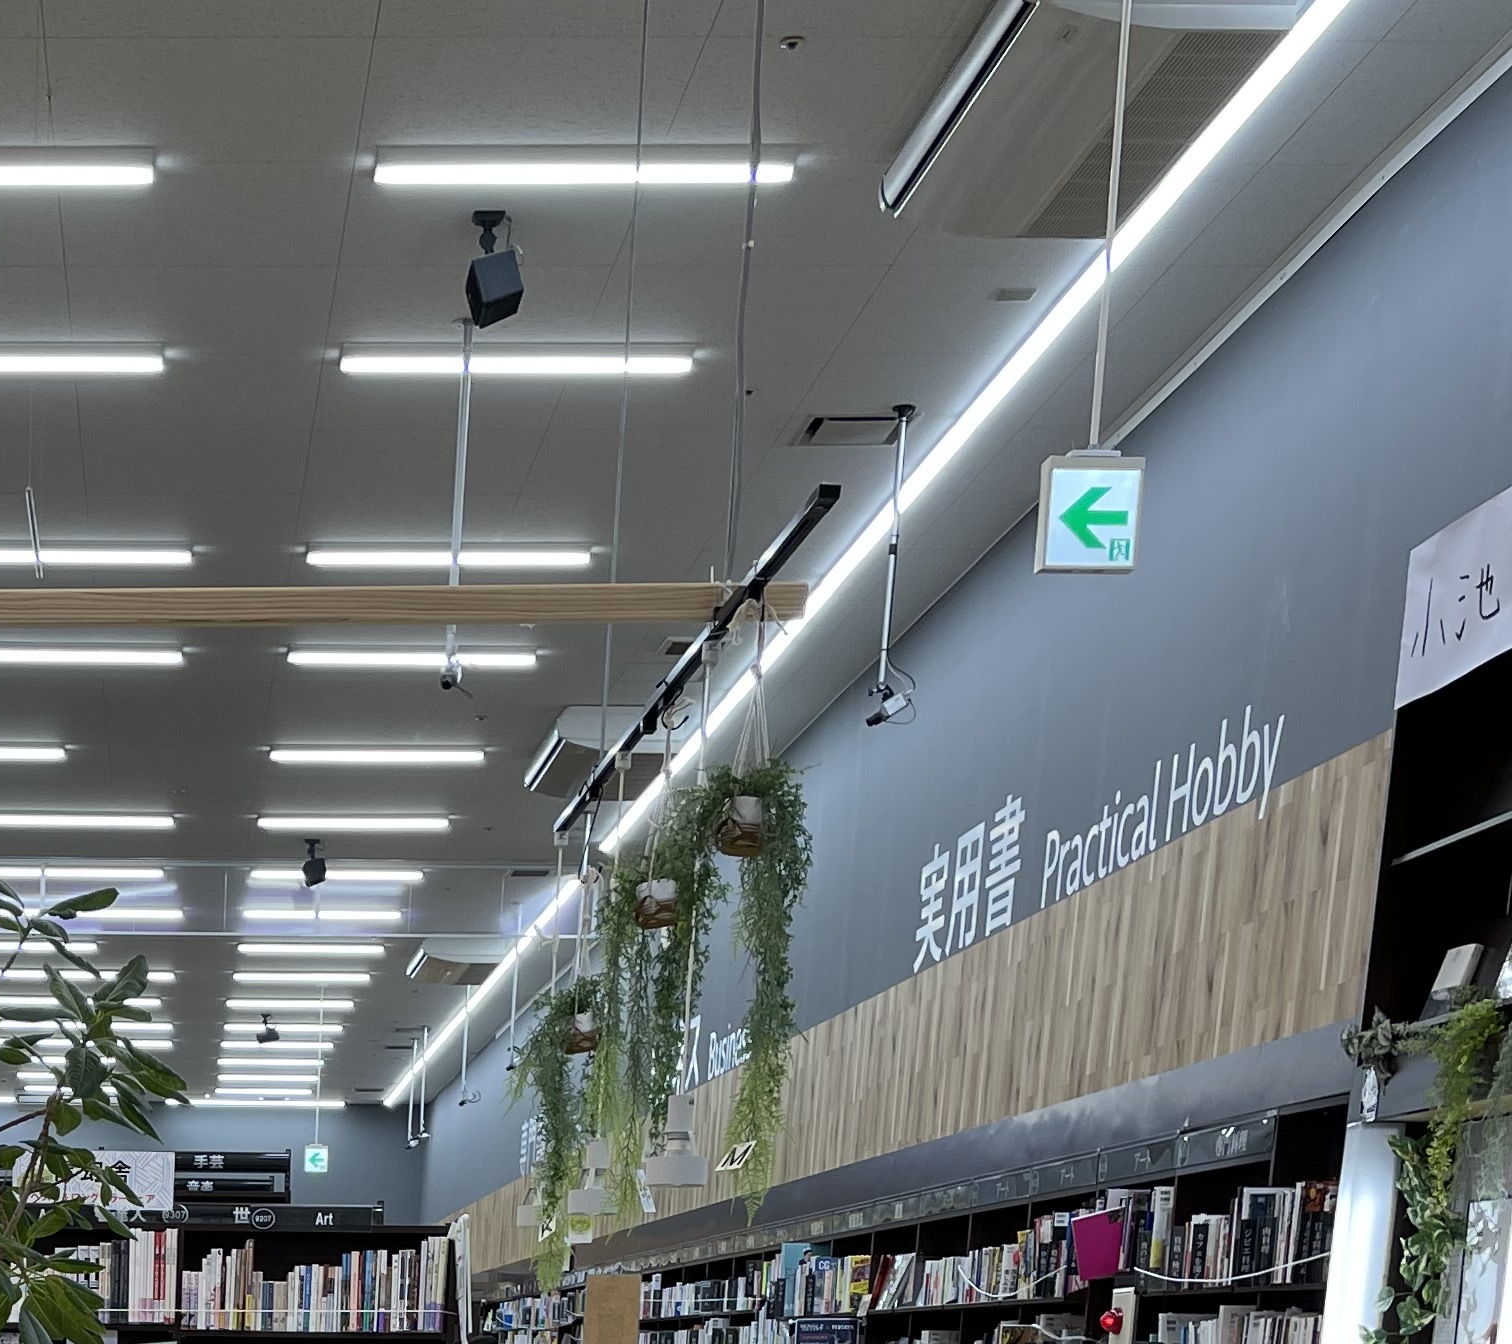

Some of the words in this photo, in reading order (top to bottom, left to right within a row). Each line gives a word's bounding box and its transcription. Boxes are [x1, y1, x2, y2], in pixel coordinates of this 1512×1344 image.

[1410, 563, 1501, 658] 小池
[1040, 761, 1163, 909] Practical
[1165, 705, 1287, 842] Hobby
[912, 795, 1027, 974] 実用書
[720, 1144, 753, 1169] M
[315, 1212, 334, 1226] Art
